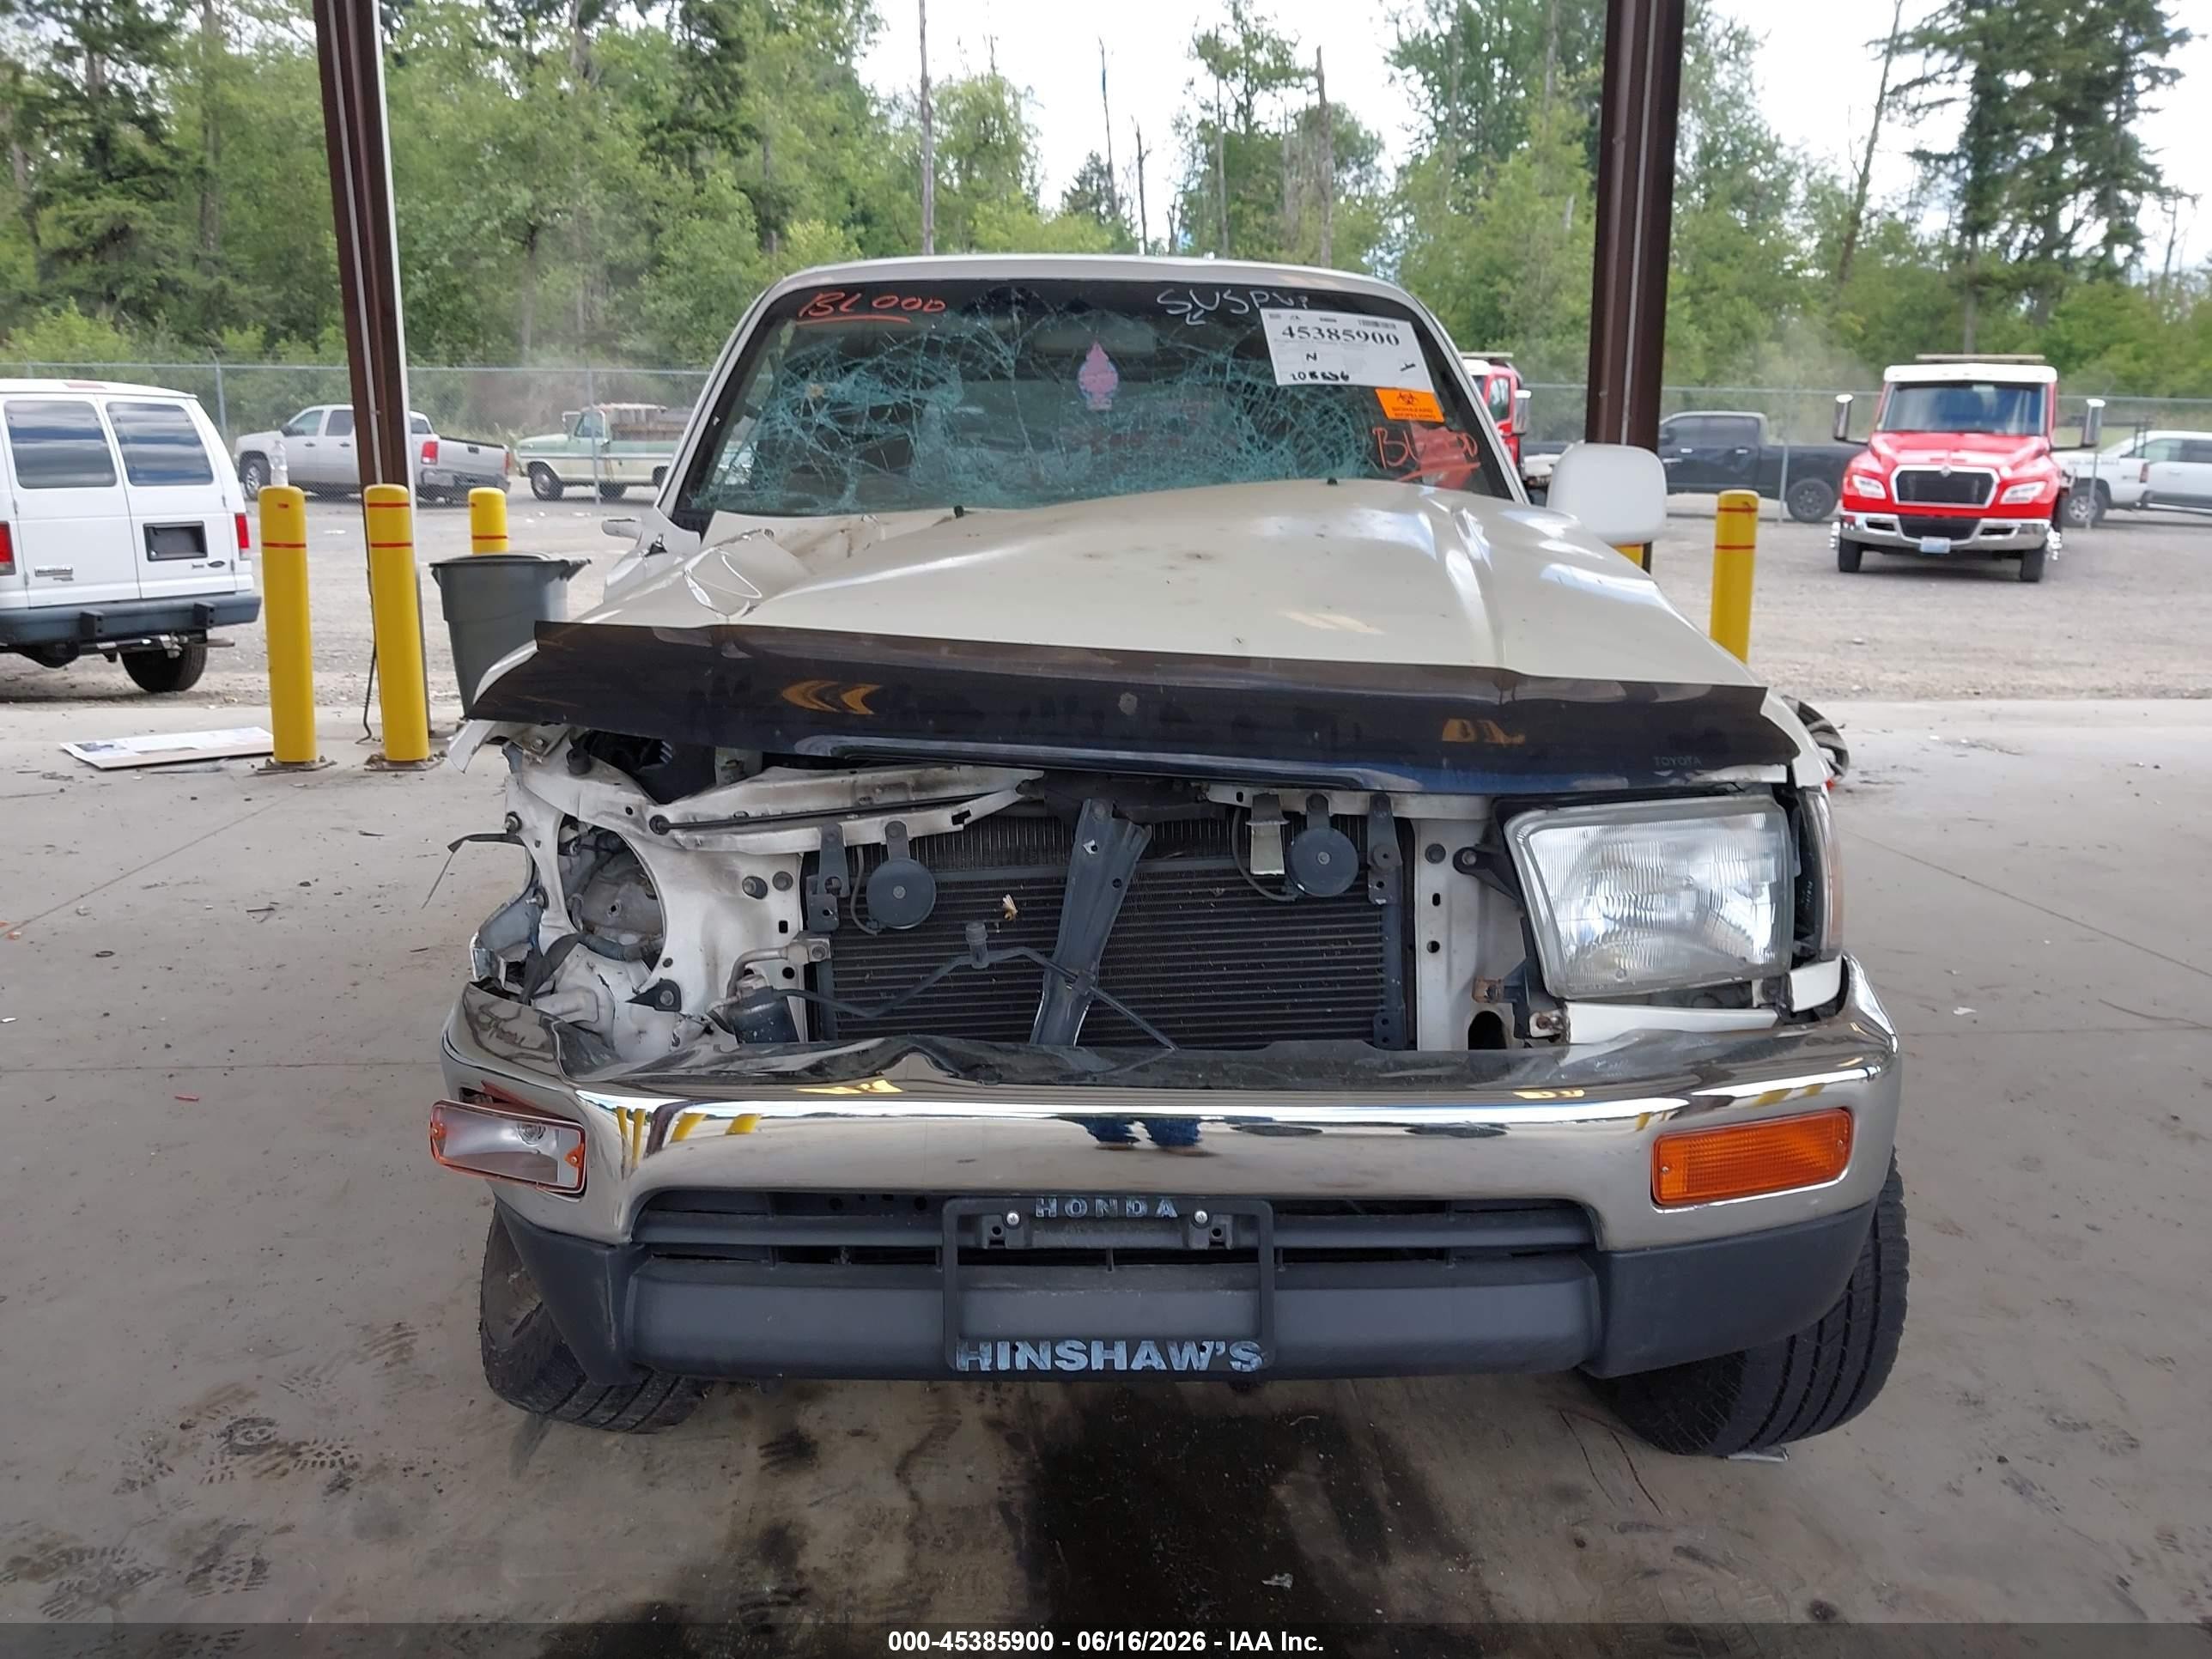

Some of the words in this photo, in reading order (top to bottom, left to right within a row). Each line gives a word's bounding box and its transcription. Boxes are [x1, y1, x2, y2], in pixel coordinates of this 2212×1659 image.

[799, 290, 947, 318] BLOOD
[1282, 325, 1401, 347] 45385900
[1653, 755, 1703, 767] TOYOTA
[1035, 1196, 1178, 1218] HONDA
[955, 1340, 1265, 1373] HINSHAW'S
